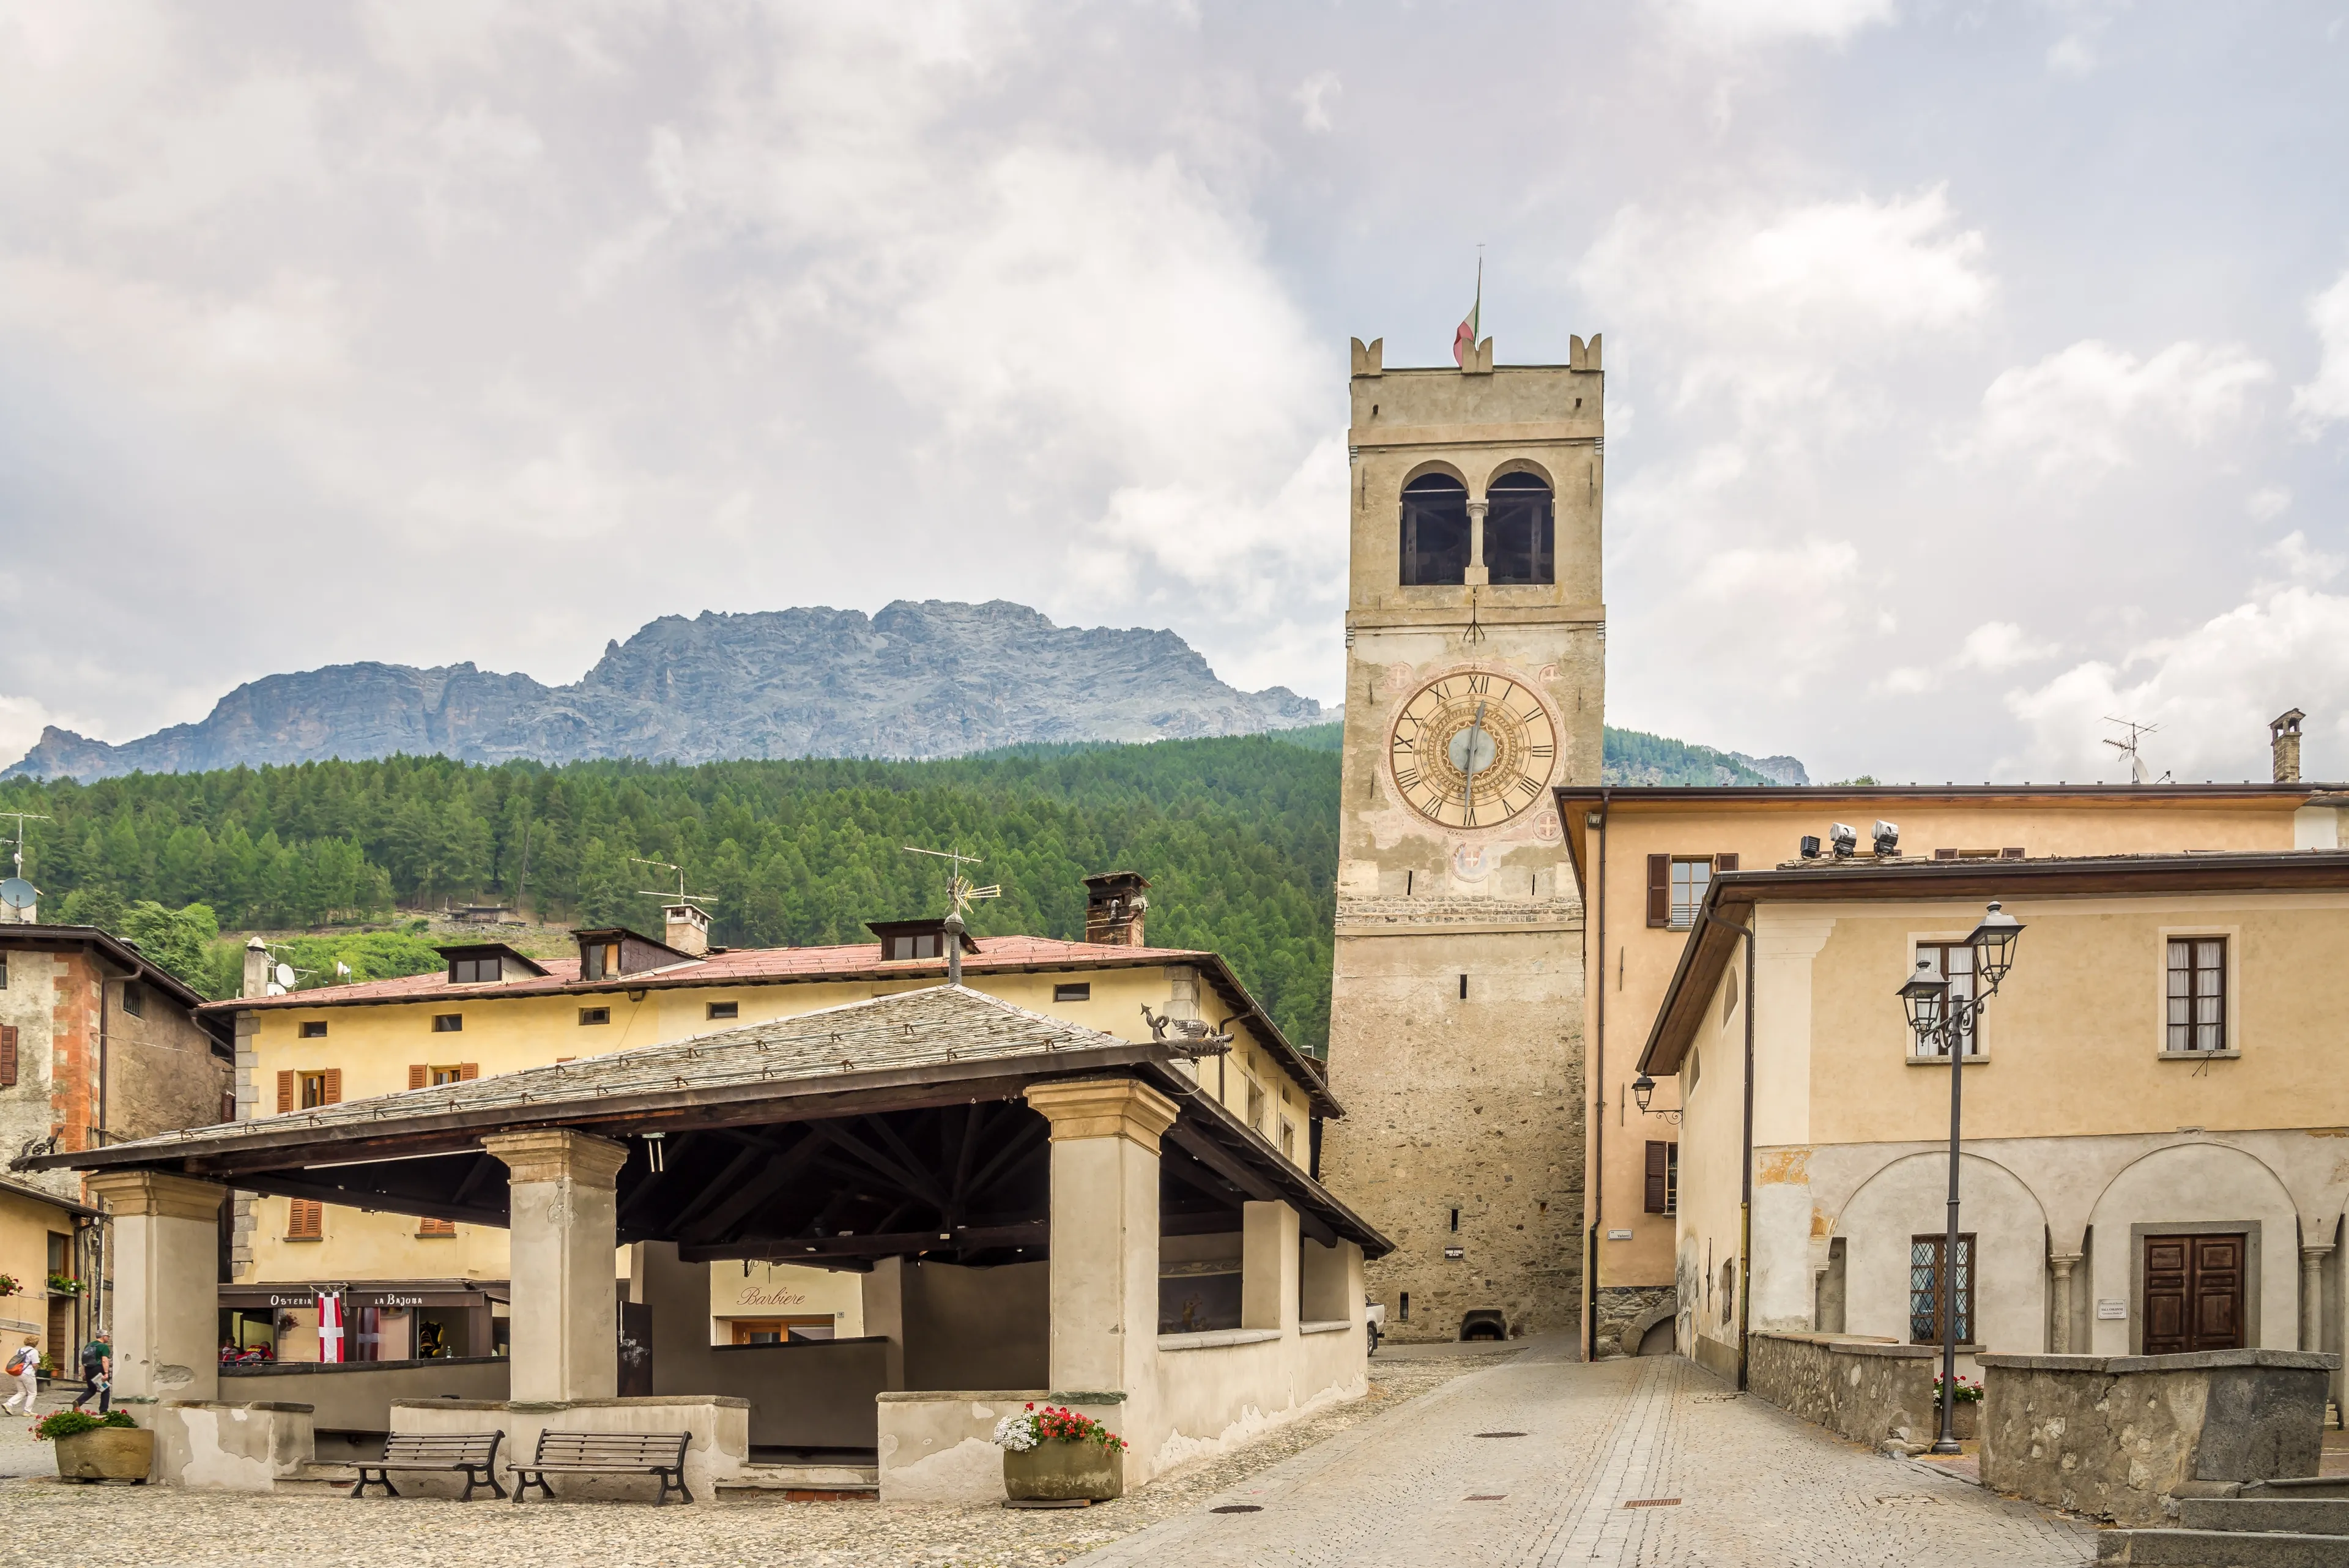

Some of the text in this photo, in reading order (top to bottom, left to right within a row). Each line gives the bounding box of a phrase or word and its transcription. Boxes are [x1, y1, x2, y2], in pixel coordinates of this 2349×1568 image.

[1428, 681, 1451, 704] XI
[1467, 675, 1489, 694] XII
[1402, 710, 1423, 728] X
[1523, 707, 1543, 723] II
[1394, 734, 1413, 754] IX
[1532, 745, 1553, 757] III
[1421, 796, 1443, 818] VII
[1502, 799, 1516, 816] V
[737, 1287, 805, 1305] Barbiere
